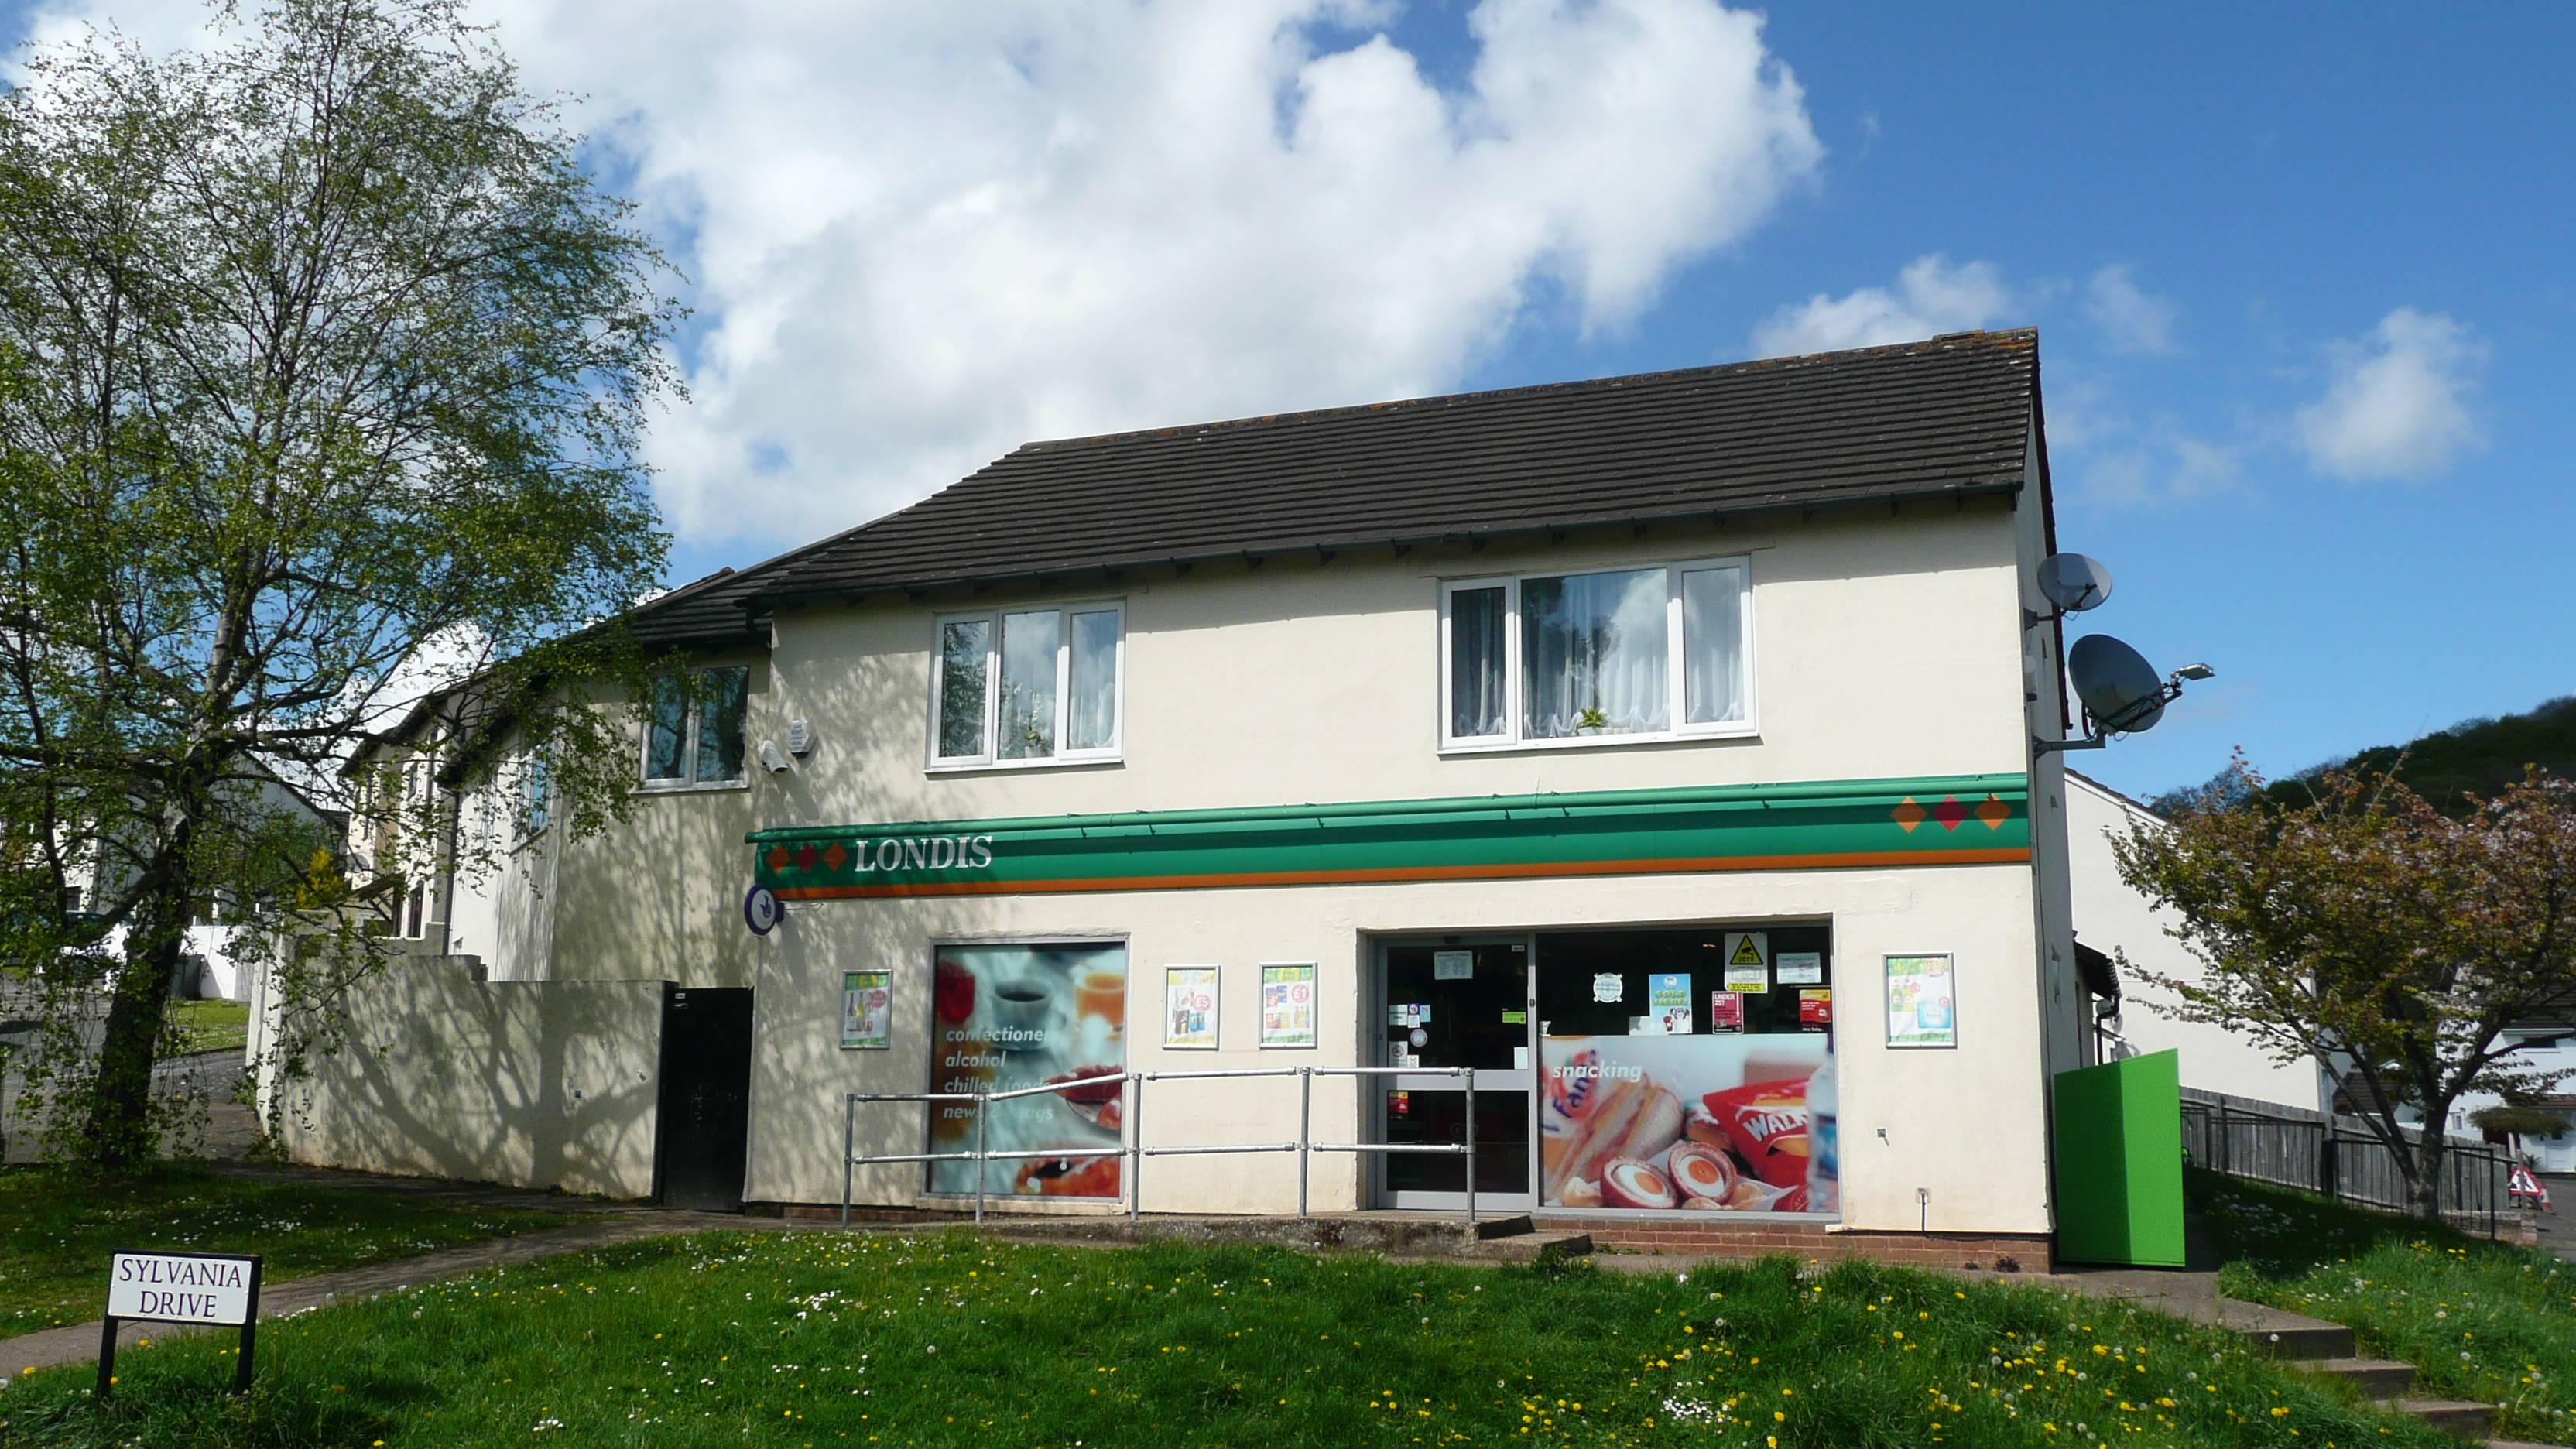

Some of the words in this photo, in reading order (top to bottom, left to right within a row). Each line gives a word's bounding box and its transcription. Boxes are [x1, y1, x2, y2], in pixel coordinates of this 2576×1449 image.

[855, 835, 992, 872] LONDIS
[946, 1026, 1058, 1043] confectioner
[944, 1050, 1007, 1067] alcohol
[1553, 1059, 1642, 1083] snacking
[944, 1076, 1001, 1093] chilled
[119, 1259, 242, 1288] SYLVANIA
[139, 1290, 217, 1317] DRIVE
